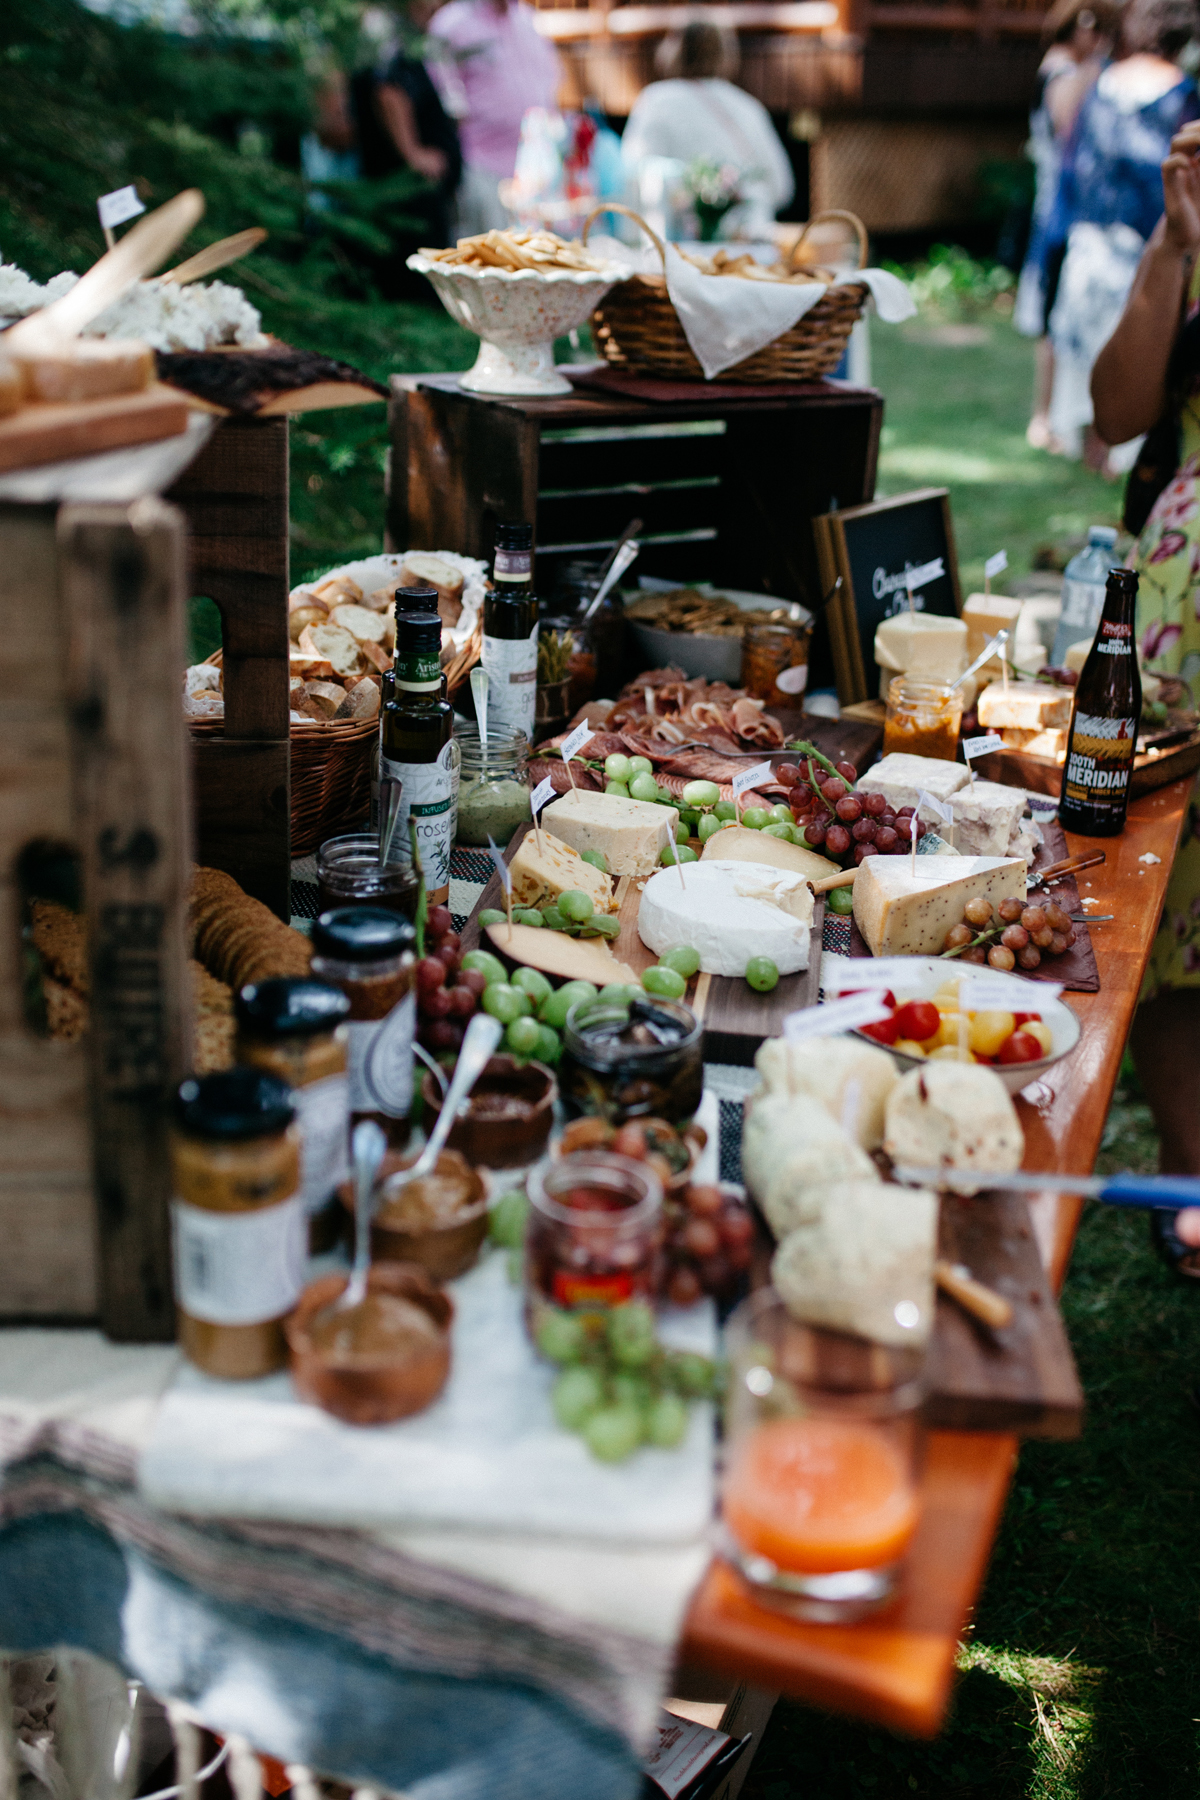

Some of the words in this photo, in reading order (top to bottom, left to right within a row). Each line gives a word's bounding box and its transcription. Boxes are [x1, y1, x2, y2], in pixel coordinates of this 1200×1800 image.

[1097, 642, 1131, 655] MERIDIAN
[1070, 752, 1096, 770] 100TH
[1067, 764, 1129, 788] MERIDIAN
